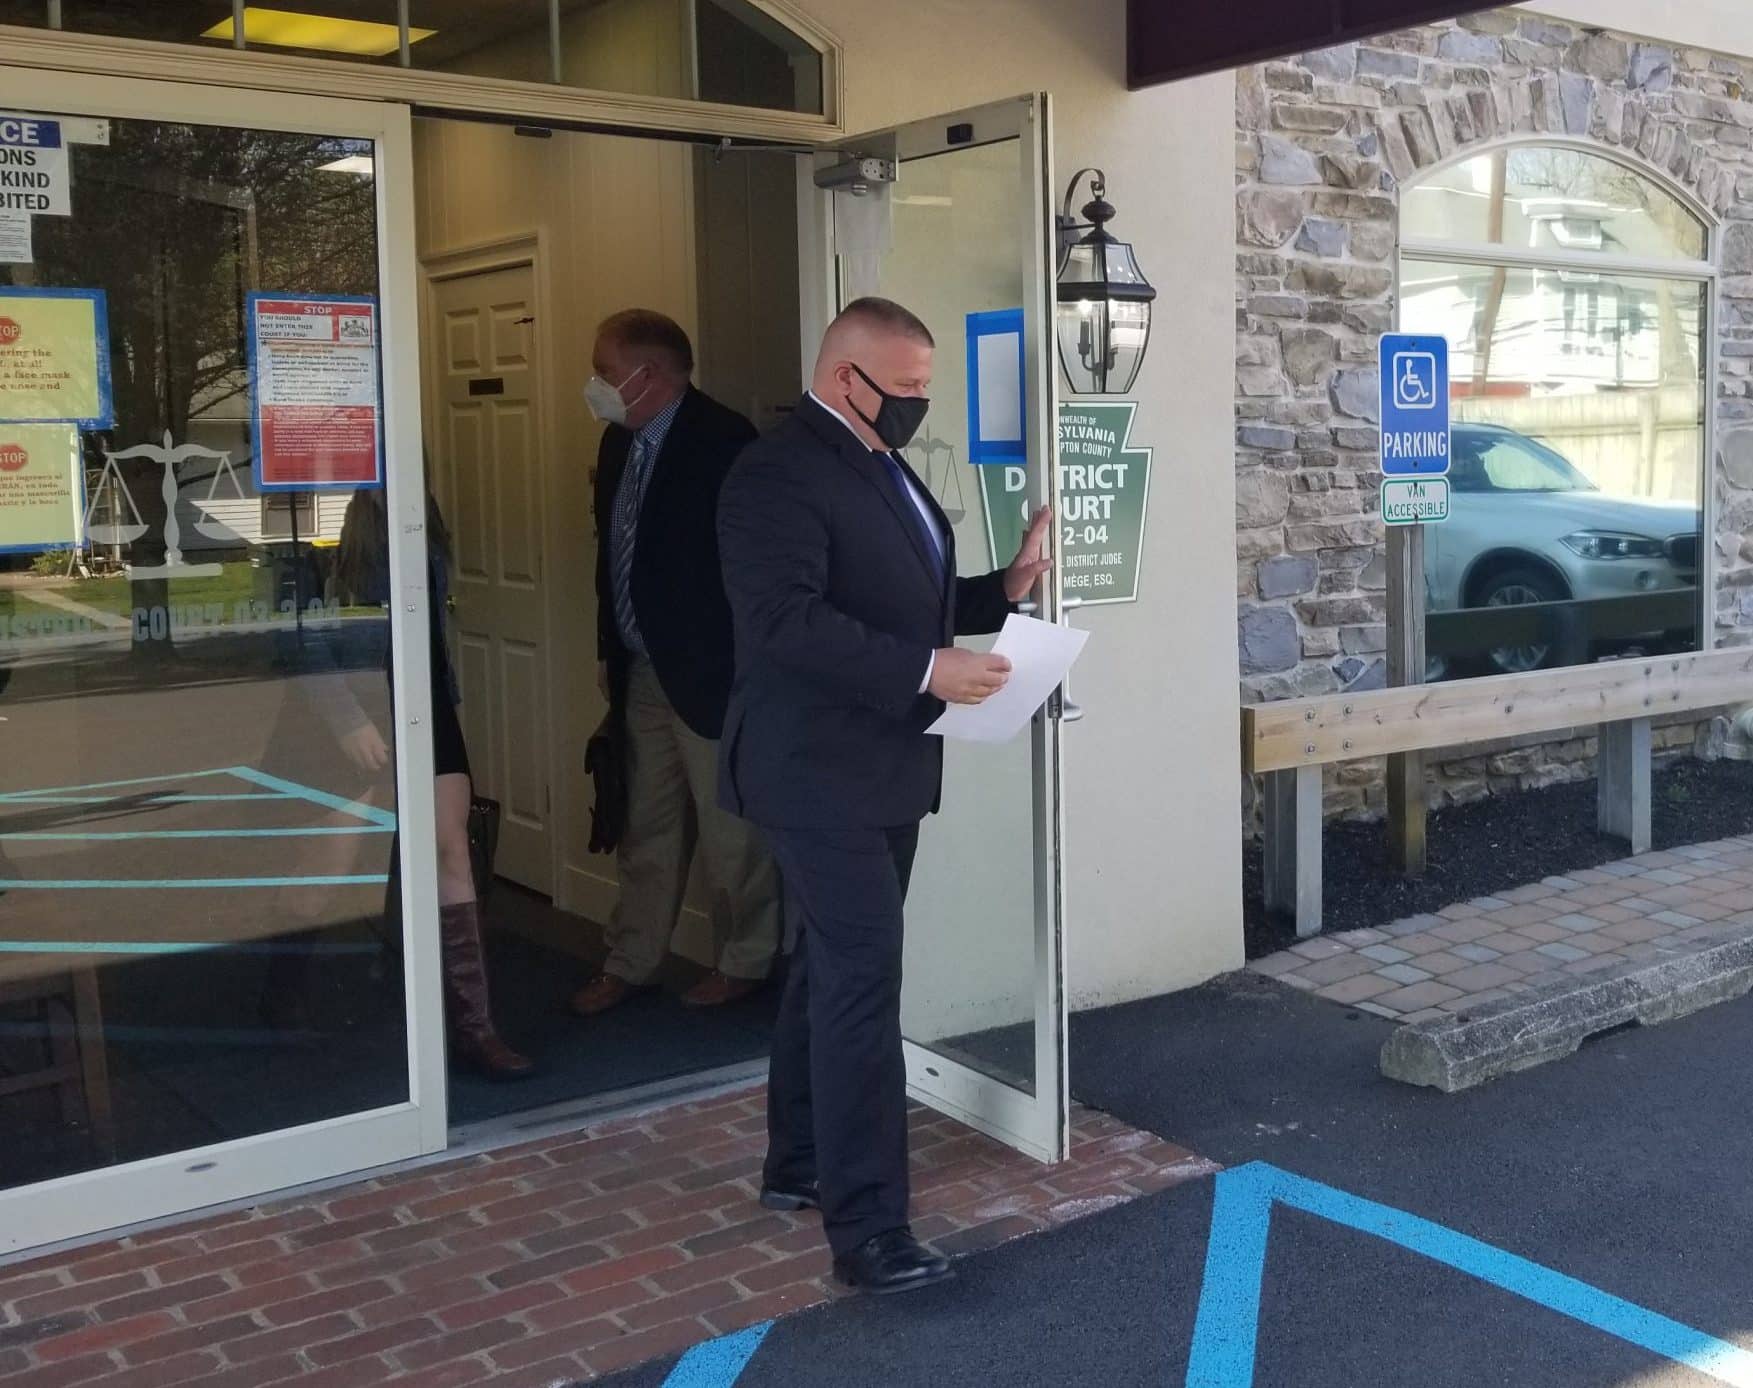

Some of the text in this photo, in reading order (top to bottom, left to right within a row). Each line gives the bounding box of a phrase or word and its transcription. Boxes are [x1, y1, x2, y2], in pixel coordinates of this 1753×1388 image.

[0, 120, 40, 145] CE
[0, 148, 36, 166] ONS
[1, 170, 50, 188] KIND
[303, 305, 333, 314] STOP
[33, 349, 54, 357] the
[15, 370, 38, 379] face
[41, 370, 72, 379] mask
[39, 381, 61, 390] and
[1088, 416, 1097, 425] OF
[1058, 425, 1116, 445] SYLVANIA
[1060, 441, 1113, 459] PTON COUNTY
[1383, 431, 1447, 459] PARKING
[1005, 463, 1129, 492] DTRICT
[1407, 484, 1426, 498] VAN
[1387, 501, 1445, 518] ACCESSIBLE
[1066, 552, 1123, 568] DISTRICT JUDGE
[1094, 573, 1115, 587] ESQ.
